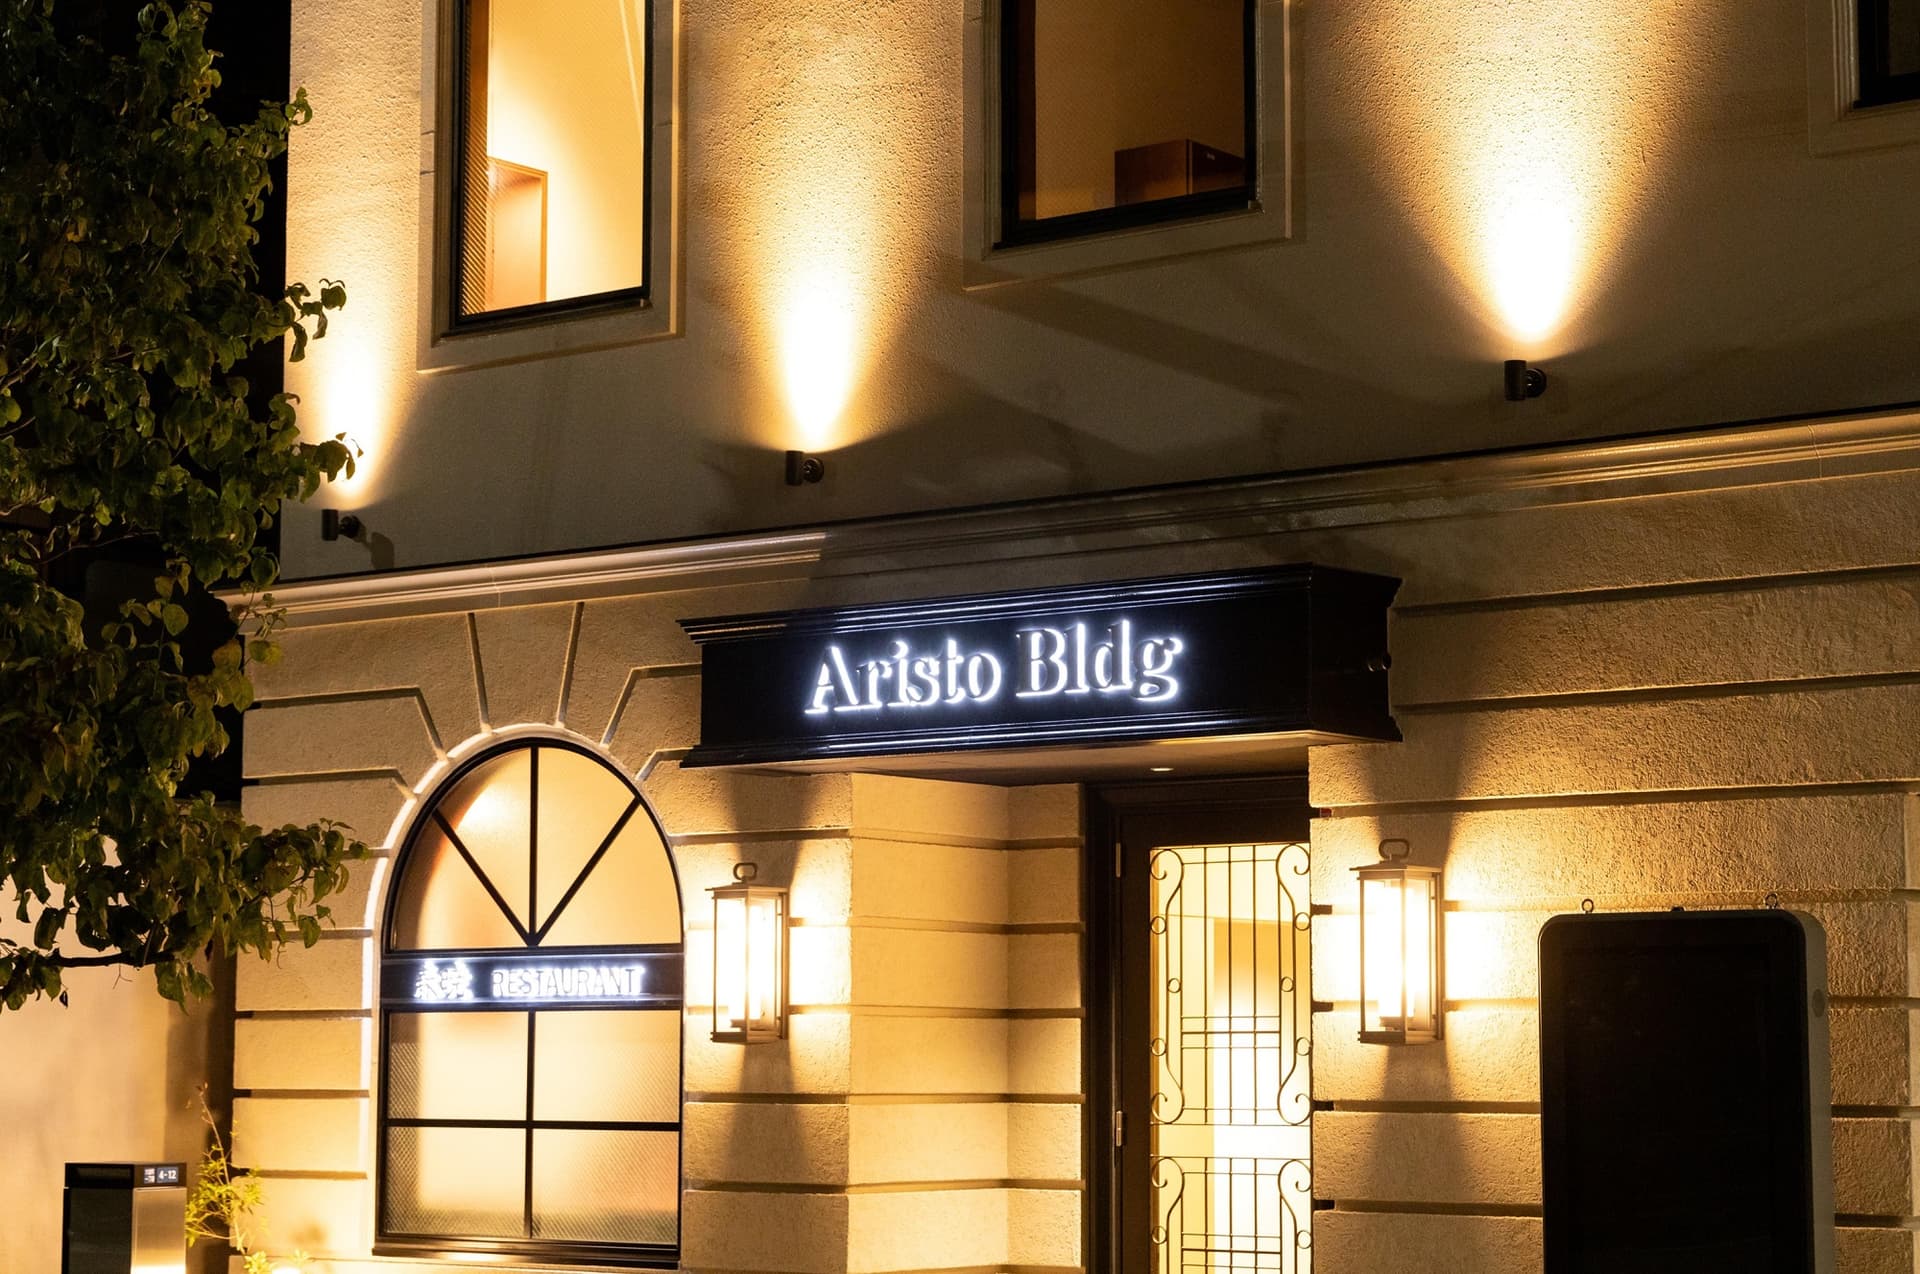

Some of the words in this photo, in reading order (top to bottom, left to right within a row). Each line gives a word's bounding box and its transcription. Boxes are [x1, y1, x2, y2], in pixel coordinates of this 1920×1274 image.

[804, 640, 1001, 714] Aristo
[1015, 620, 1184, 702] Bldg
[490, 965, 646, 998] RESTAURANT
[158, 1169, 177, 1180] 4-12
